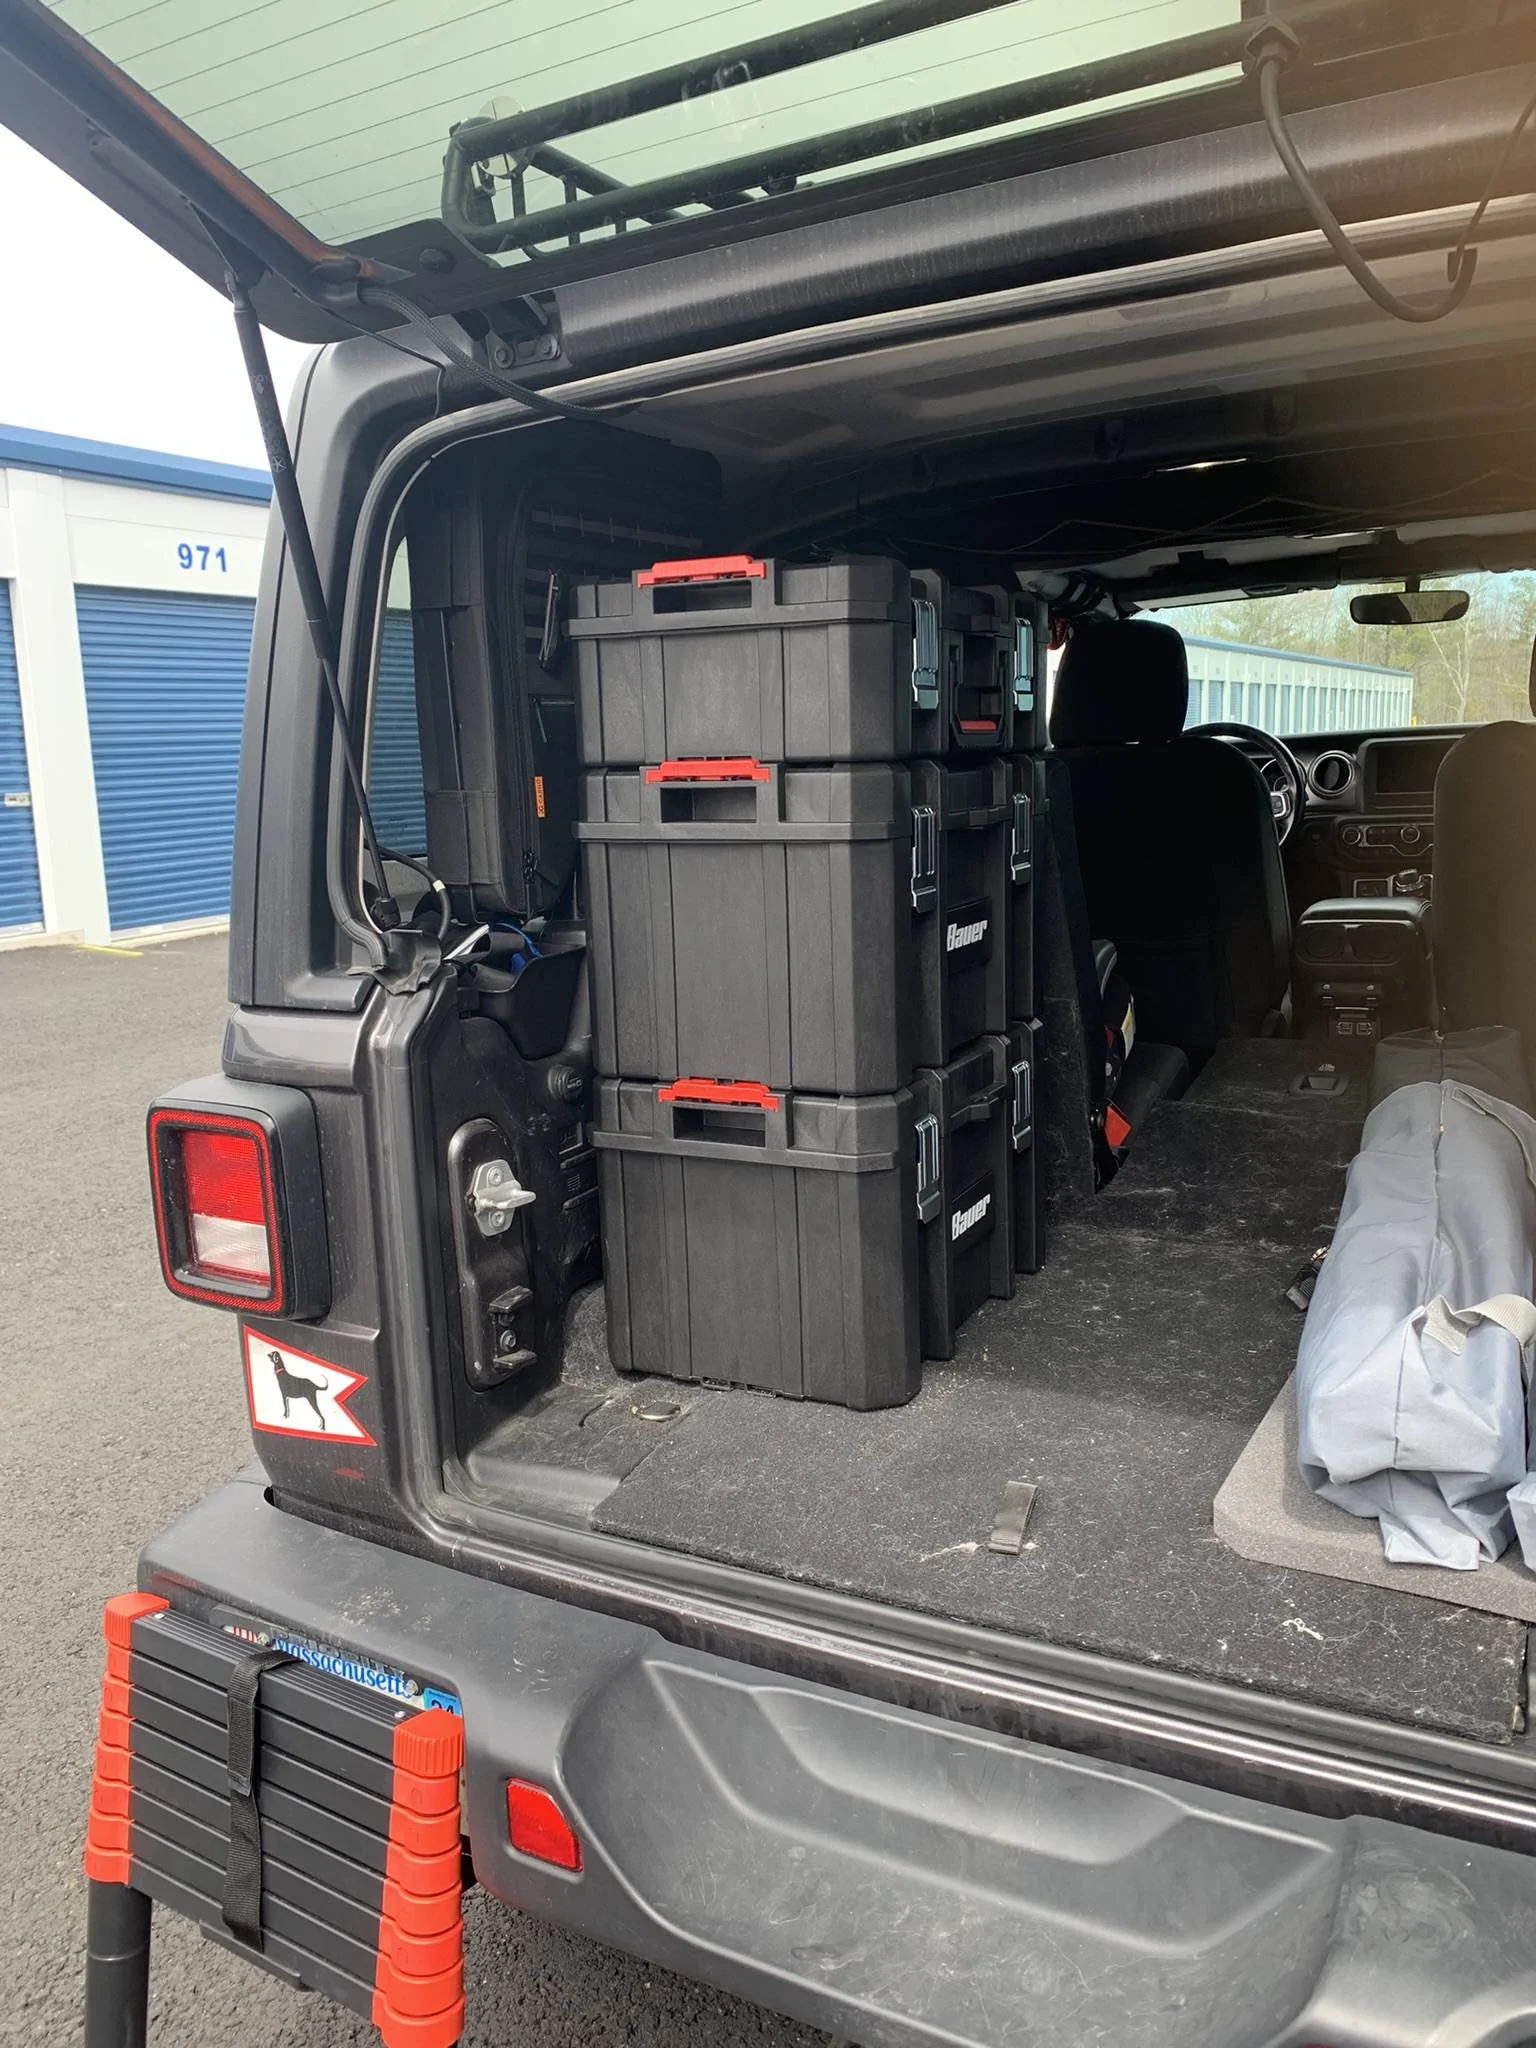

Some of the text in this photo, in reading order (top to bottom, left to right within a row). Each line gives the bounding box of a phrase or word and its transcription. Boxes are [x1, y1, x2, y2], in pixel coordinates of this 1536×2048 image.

[178, 543, 227, 573] 971
[946, 919, 988, 952] Bauer
[951, 1193, 991, 1241] Bauer
